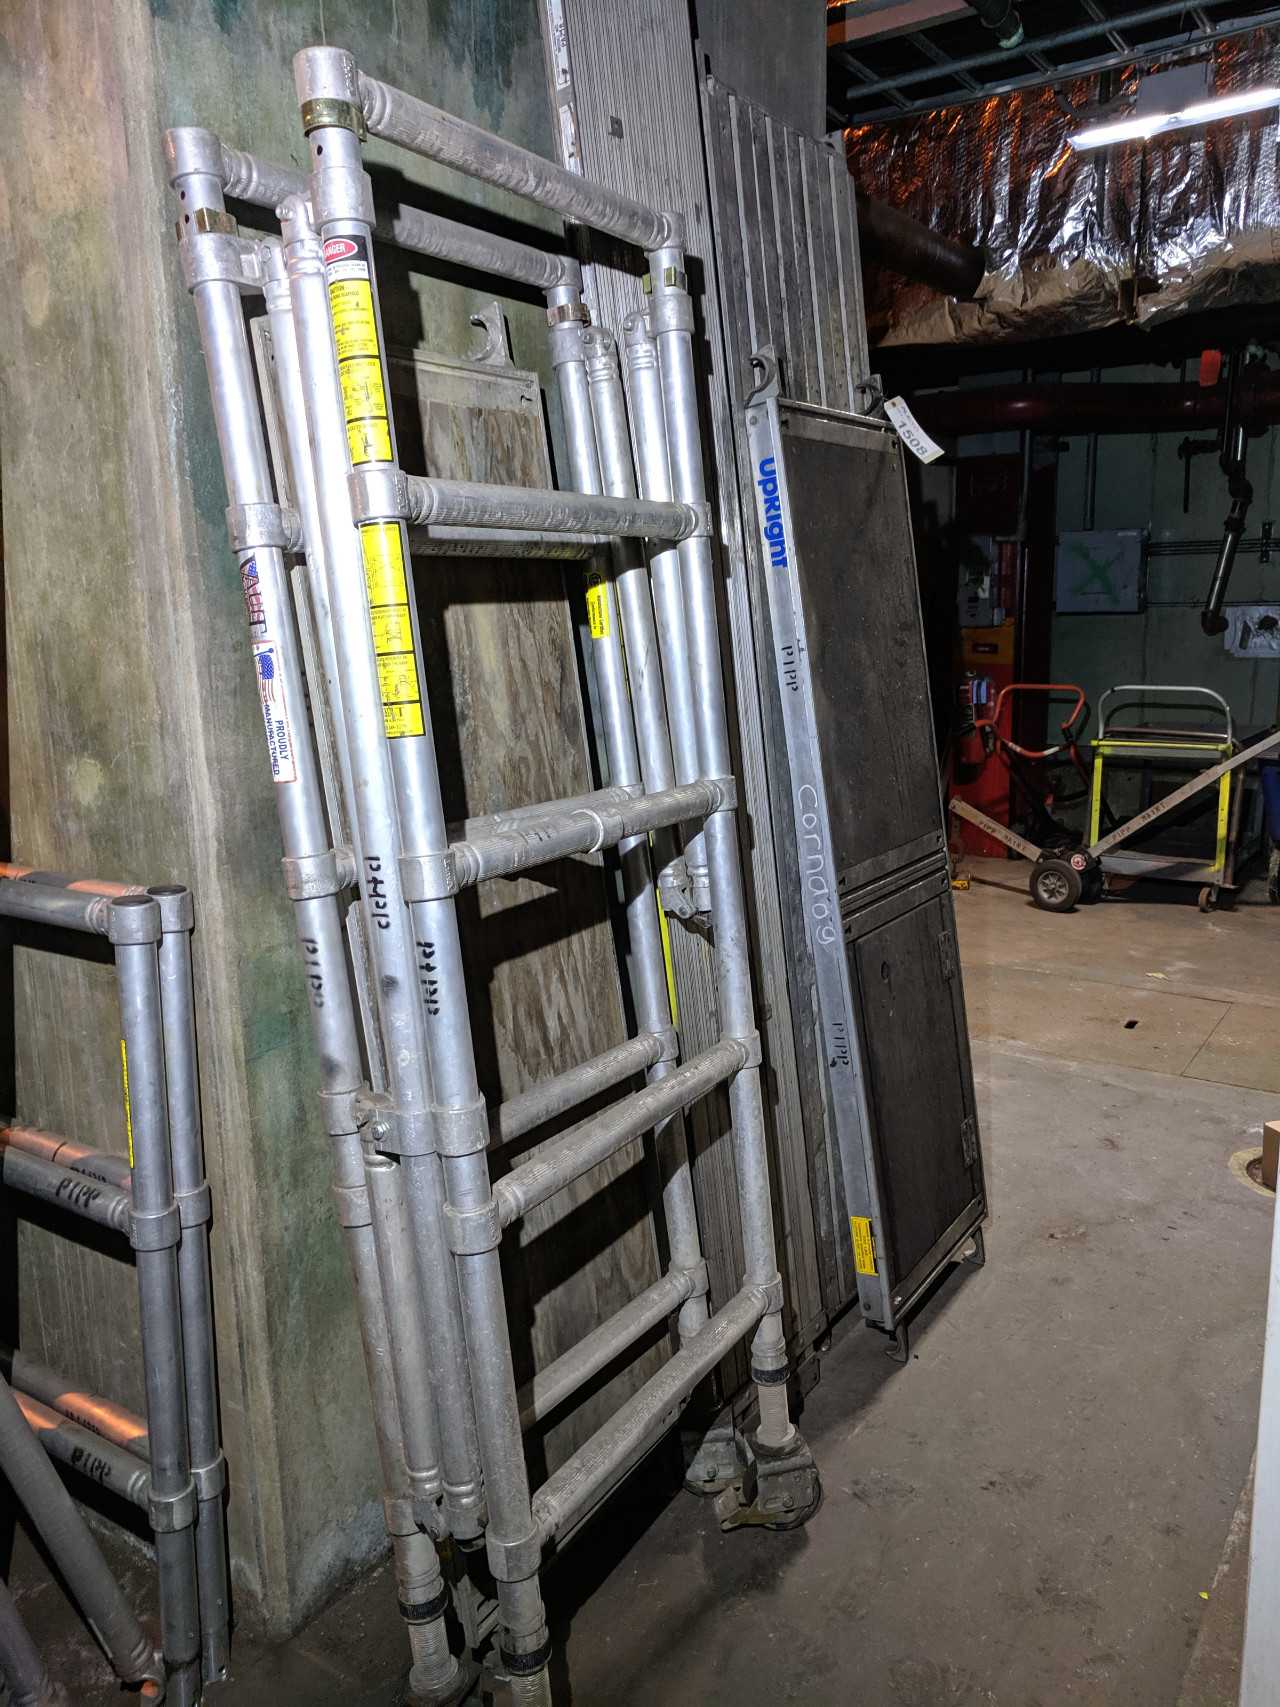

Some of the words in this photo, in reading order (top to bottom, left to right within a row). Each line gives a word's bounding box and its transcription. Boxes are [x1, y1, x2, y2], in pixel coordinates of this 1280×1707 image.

[324, 243, 346, 257] ANGER
[898, 421, 928, 456] 1508
[275, 719, 290, 761] PROUDLY
